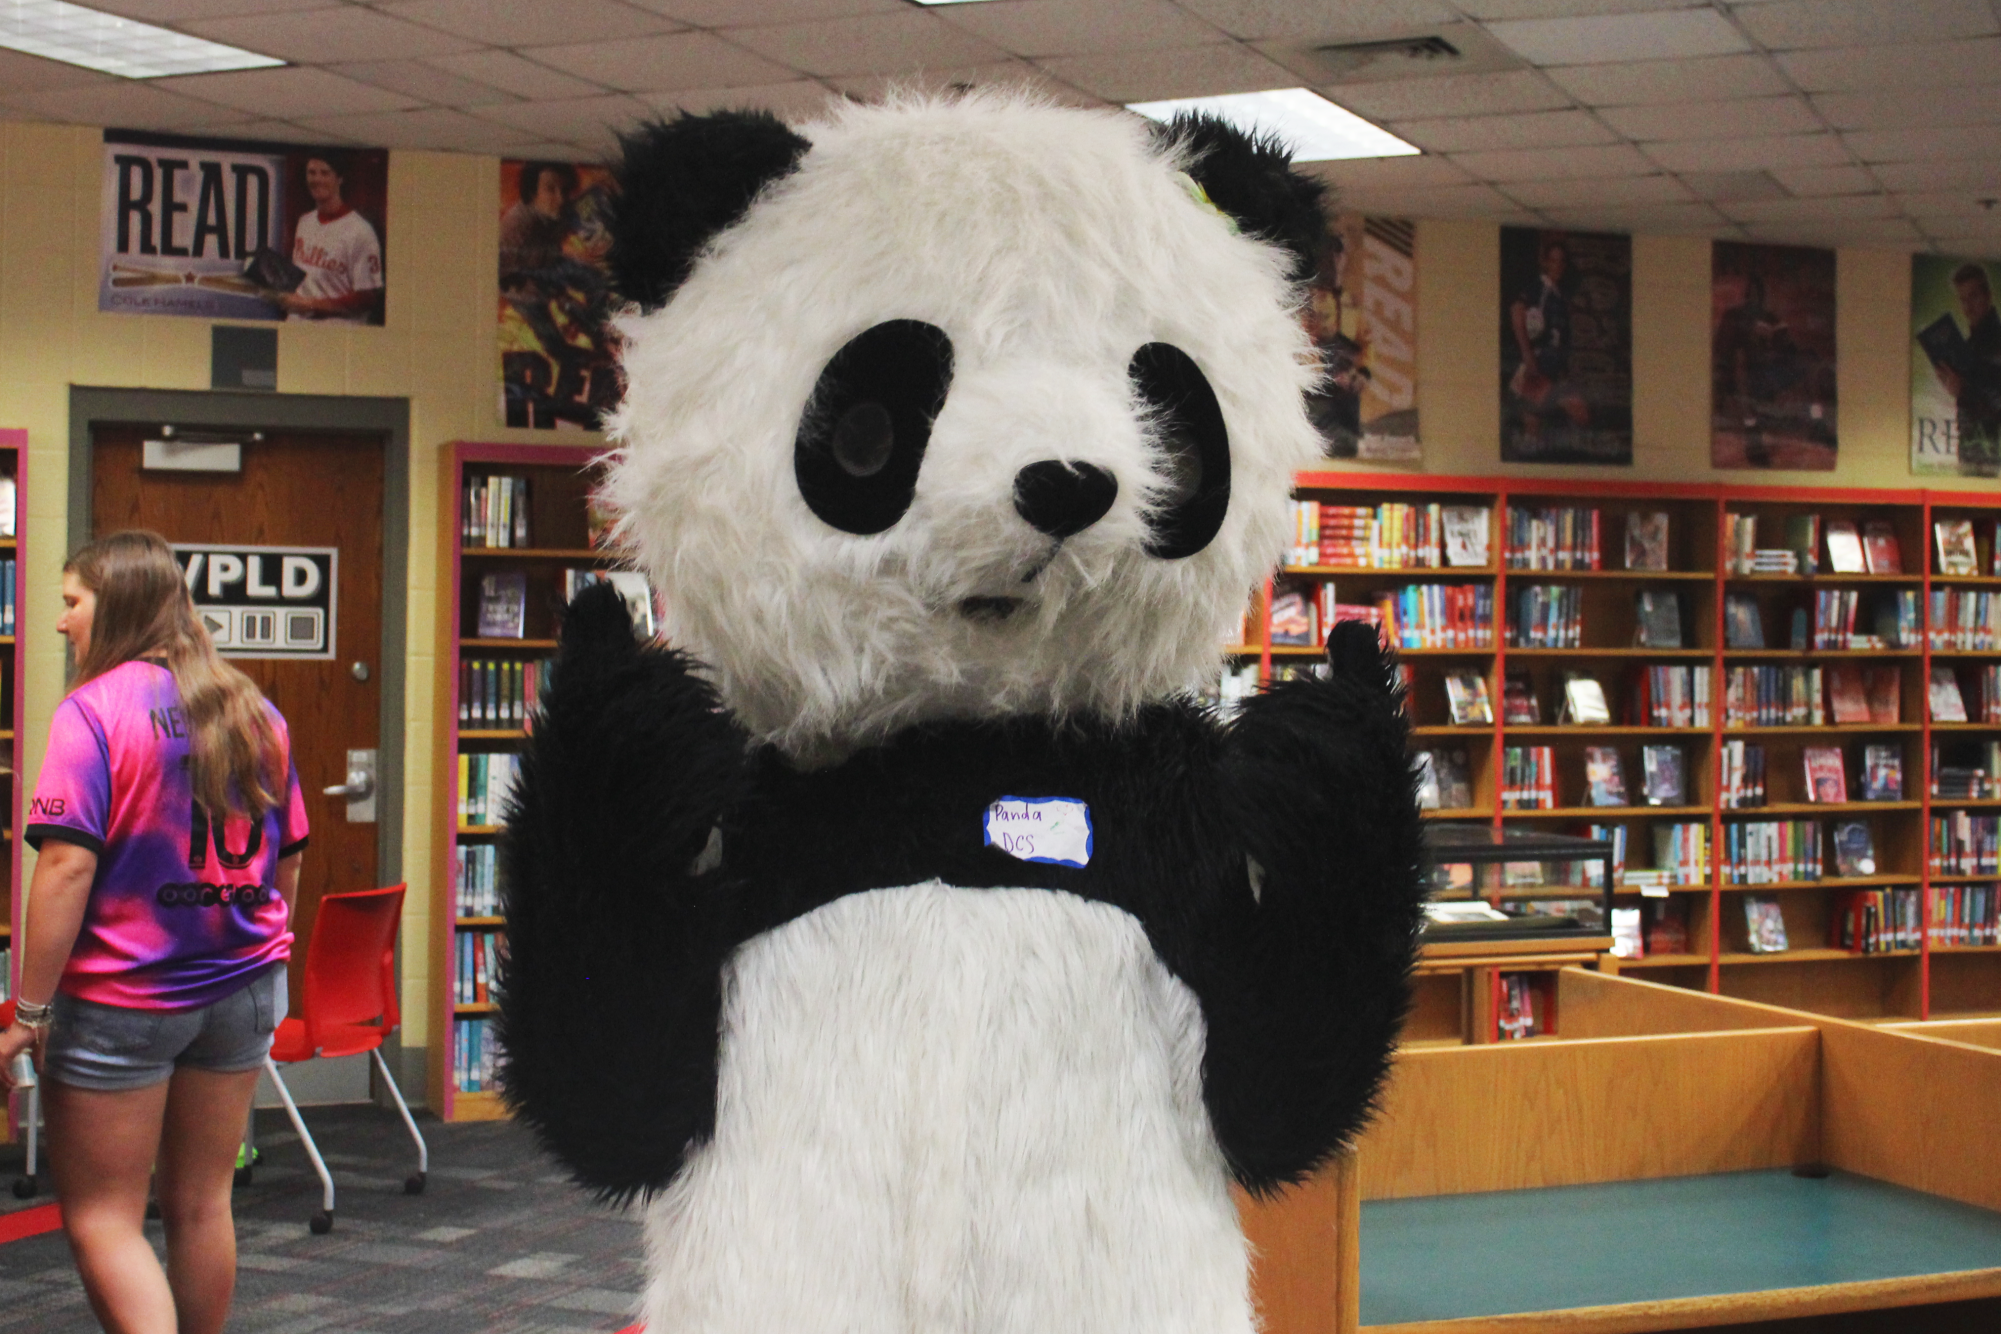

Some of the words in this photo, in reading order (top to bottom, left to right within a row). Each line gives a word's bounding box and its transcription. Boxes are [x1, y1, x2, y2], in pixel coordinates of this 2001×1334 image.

[114, 154, 270, 259] READ
[995, 803, 1042, 821] Panda
[1003, 832, 1035, 854] DCS
